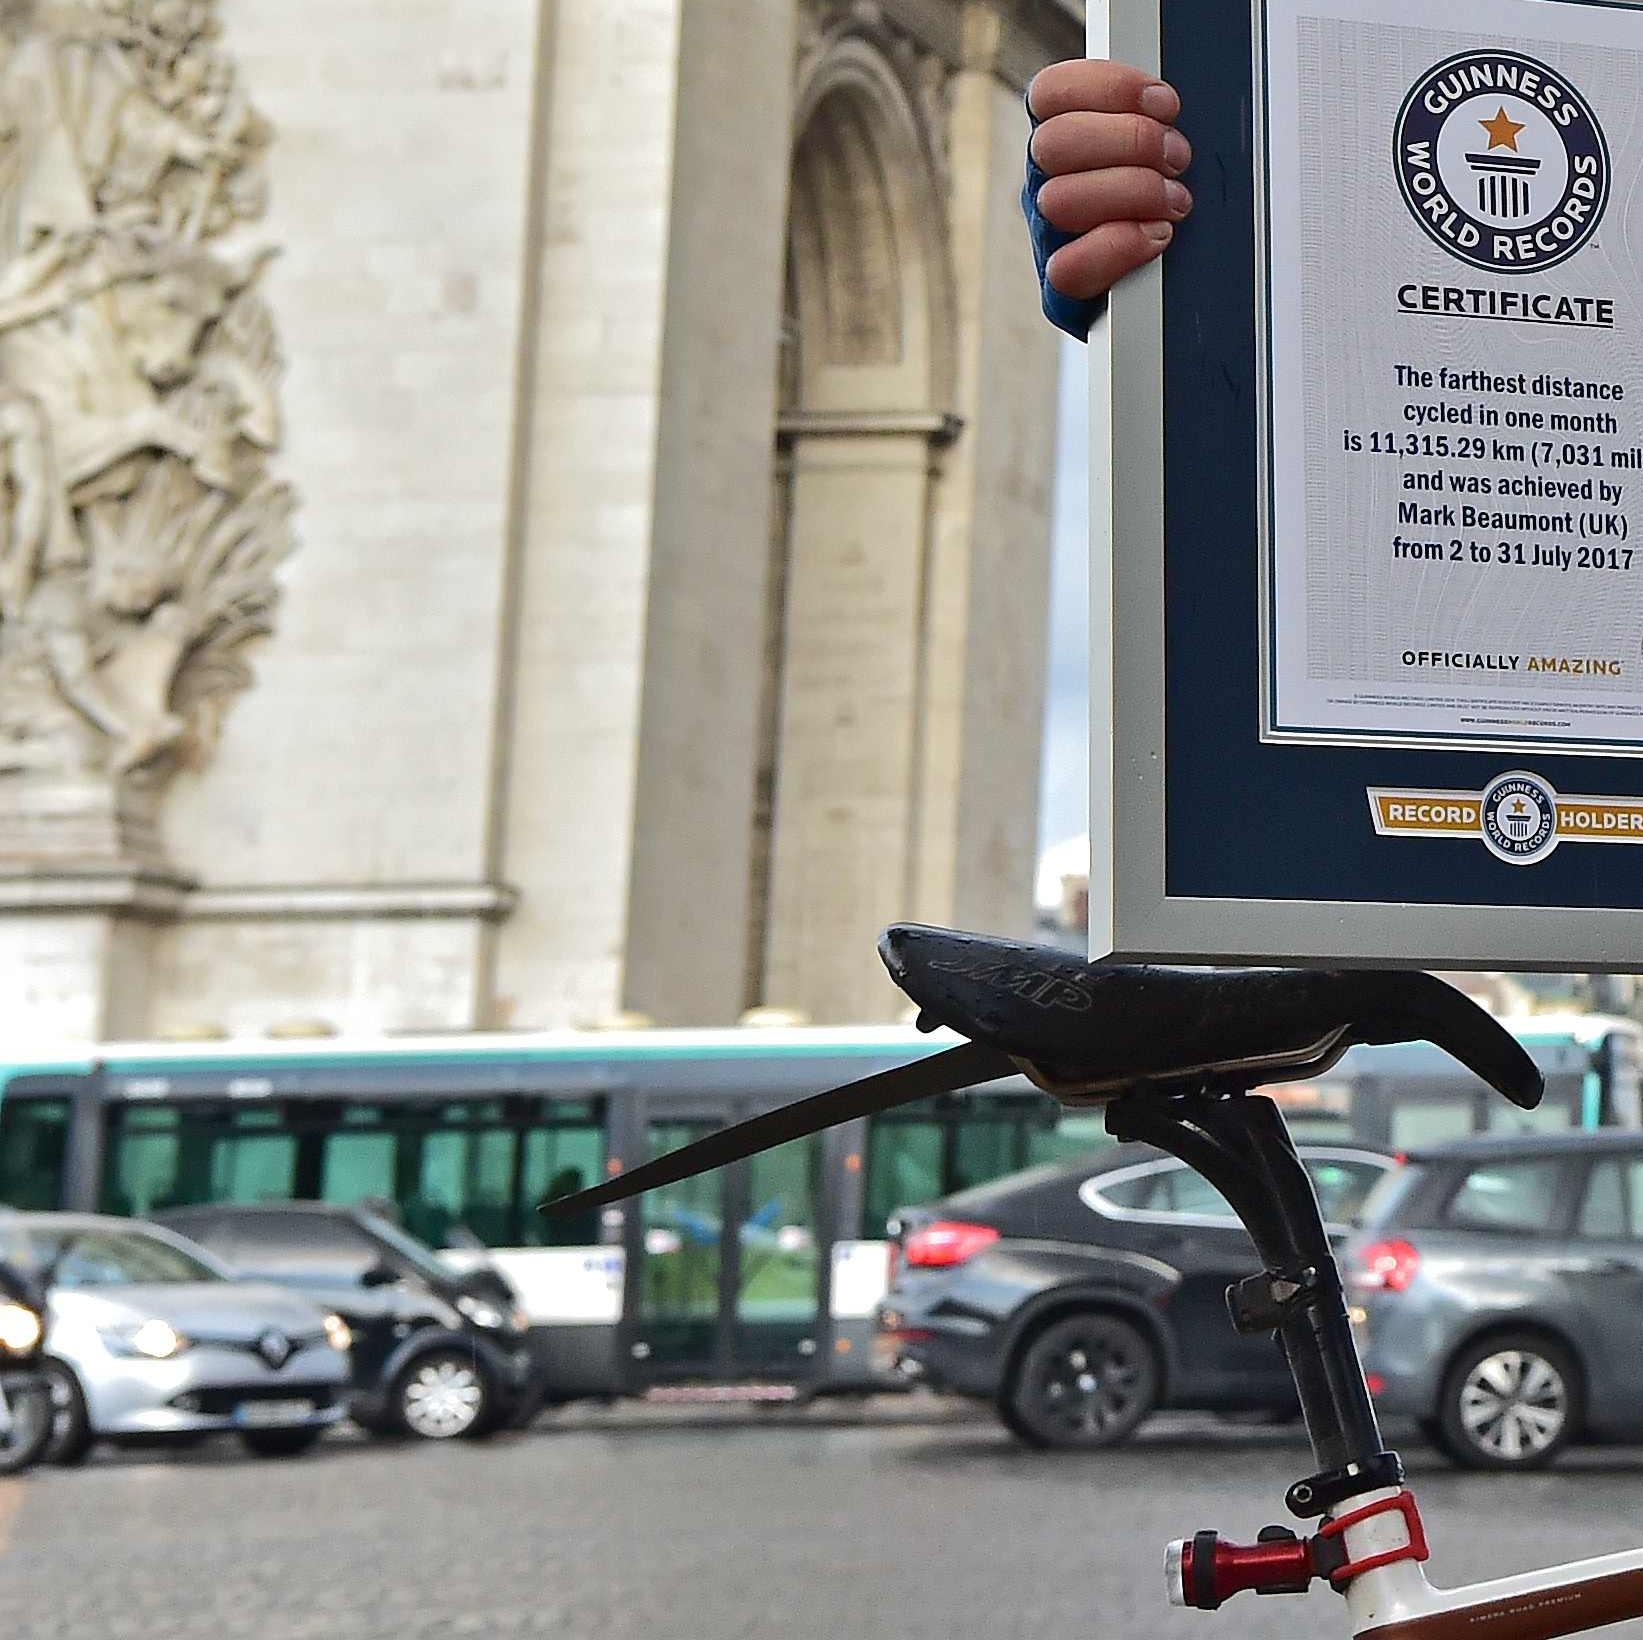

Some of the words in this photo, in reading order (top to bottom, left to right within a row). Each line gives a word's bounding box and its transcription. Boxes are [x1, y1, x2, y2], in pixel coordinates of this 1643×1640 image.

[1424, 63, 1579, 127] GUINNESS
[1407, 141, 1480, 248] WORLD
[1493, 155, 1596, 260] RECORDS
[1397, 284, 1614, 323] CERTIFICATE
[1394, 365, 1433, 388] The
[1439, 368, 1526, 395] farthest
[1532, 375, 1624, 401] distance
[1404, 403, 1472, 426] cycled
[1479, 405, 1499, 427] in
[1505, 411, 1544, 429] one
[1551, 413, 1617, 434] month
[1343, 430, 1362, 452] is
[1370, 432, 1486, 459] 11,315.29
[1492, 439, 1525, 462] km
[1531, 441, 1605, 469] (7,031
[1403, 470, 1443, 492] and
[1449, 475, 1492, 494] was
[1498, 475, 1592, 500] achieved
[1600, 480, 1623, 506] by
[1398, 502, 1455, 527] Mark
[1462, 506, 1573, 533] Beaumont
[1579, 512, 1628, 540] (UK)
[1393, 536, 1443, 560] from
[1450, 540, 1463, 561] 2
[1470, 542, 1491, 562] to
[1497, 542, 1526, 565] 31
[1532, 544, 1572, 571] July
[1577, 547, 1634, 570] 2017
[1401, 649, 1520, 671] OFFICIALLY
[1526, 655, 1622, 676] AMAZING
[1492, 783, 1545, 804] GUINNESS
[1389, 804, 1476, 823] RECORD
[1486, 811, 1511, 852] WORLD
[1514, 812, 1551, 852] RECORDS
